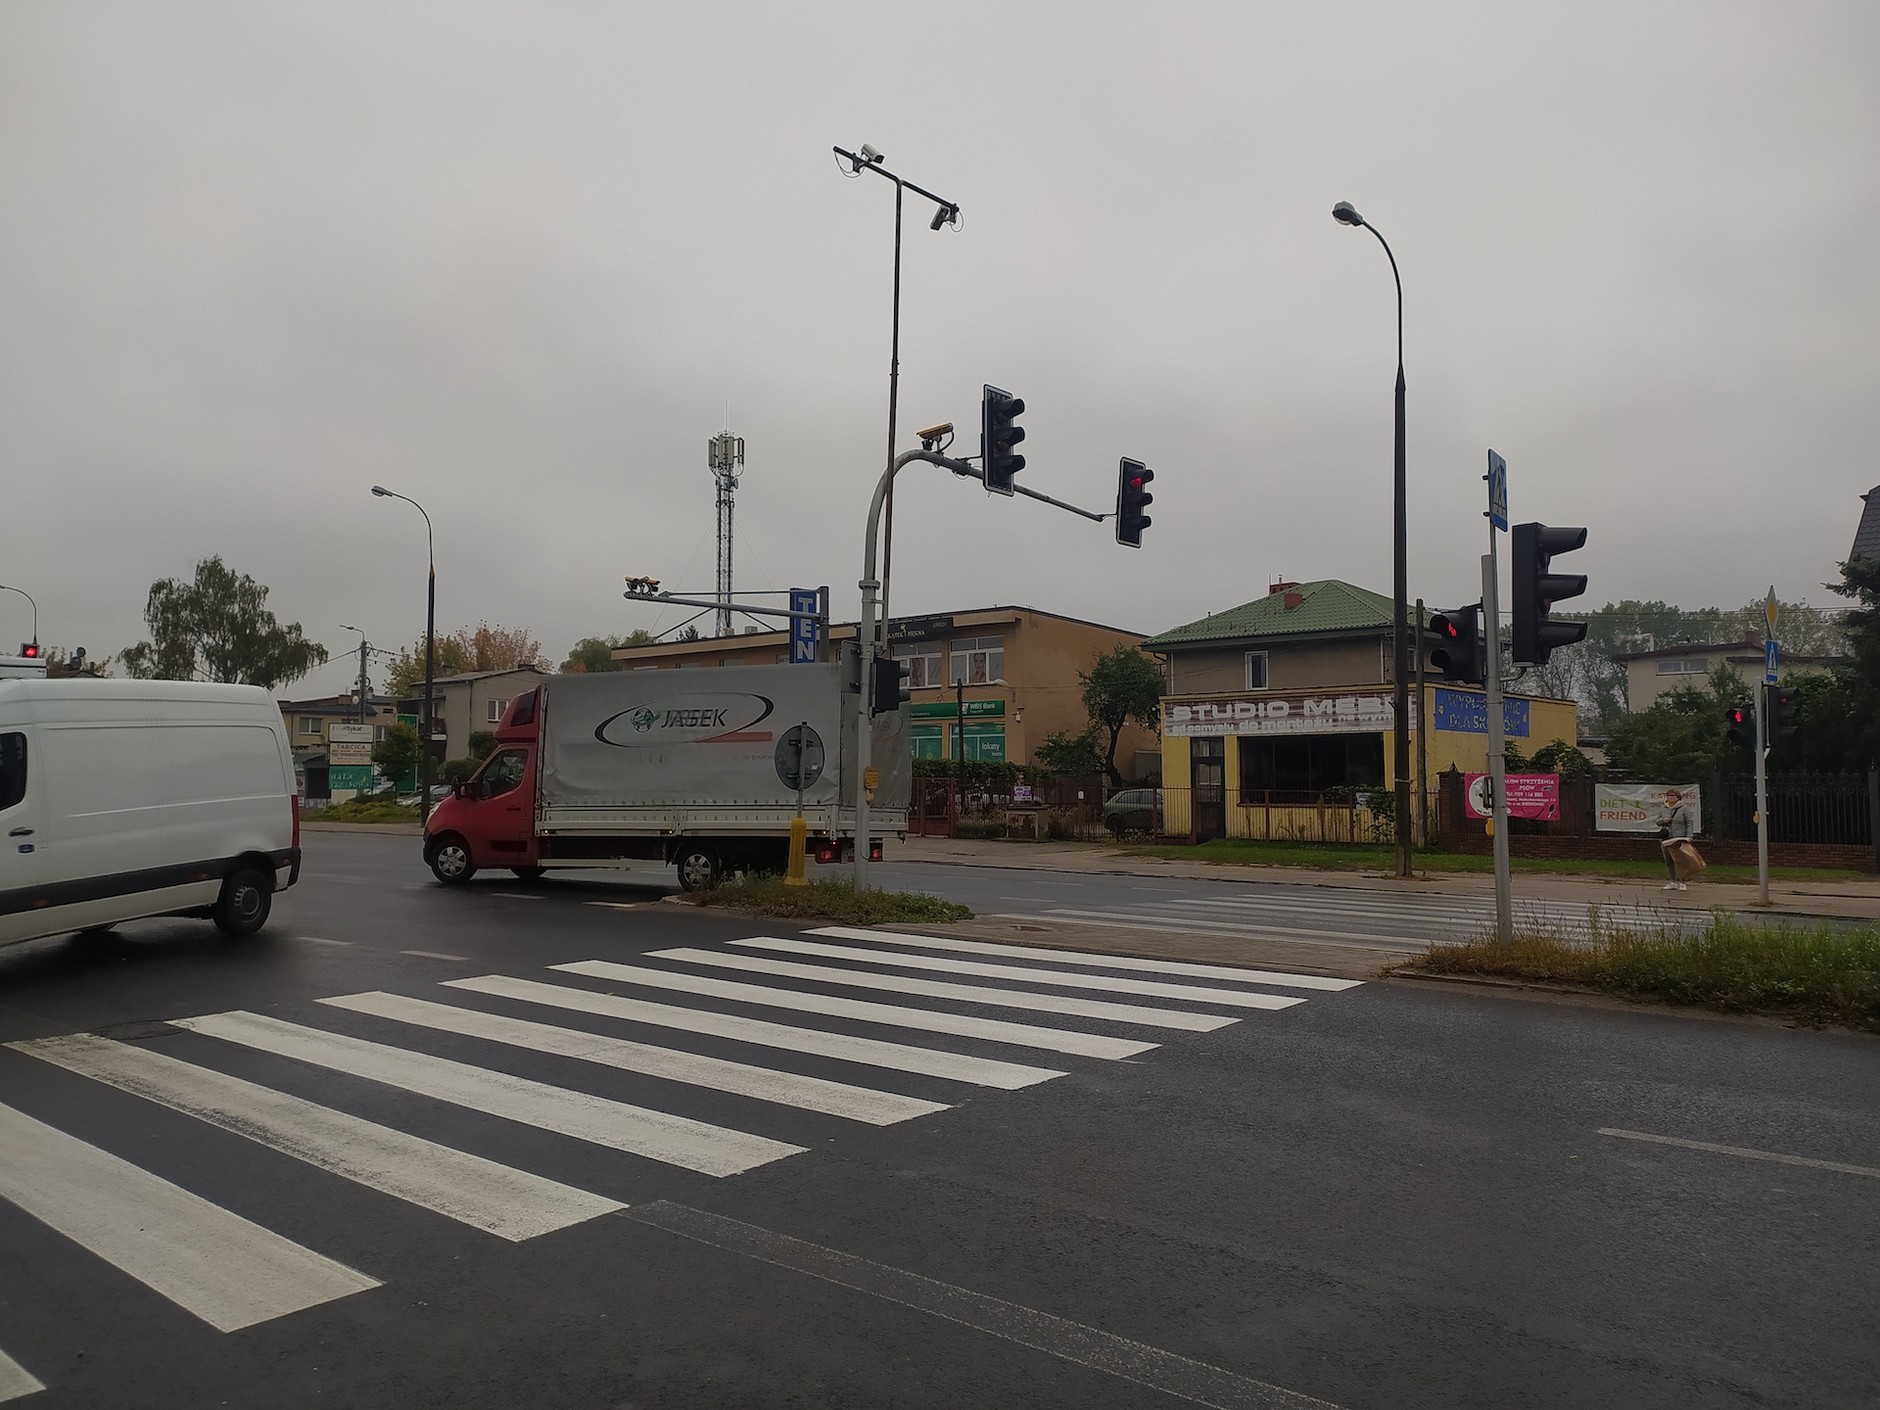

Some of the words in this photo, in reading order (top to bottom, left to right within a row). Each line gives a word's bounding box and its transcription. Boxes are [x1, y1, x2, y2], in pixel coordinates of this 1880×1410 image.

[1173, 701, 1290, 722] STUDIO
[1600, 799, 1626, 808] DIET
[1600, 810, 1647, 820] FRIEND
